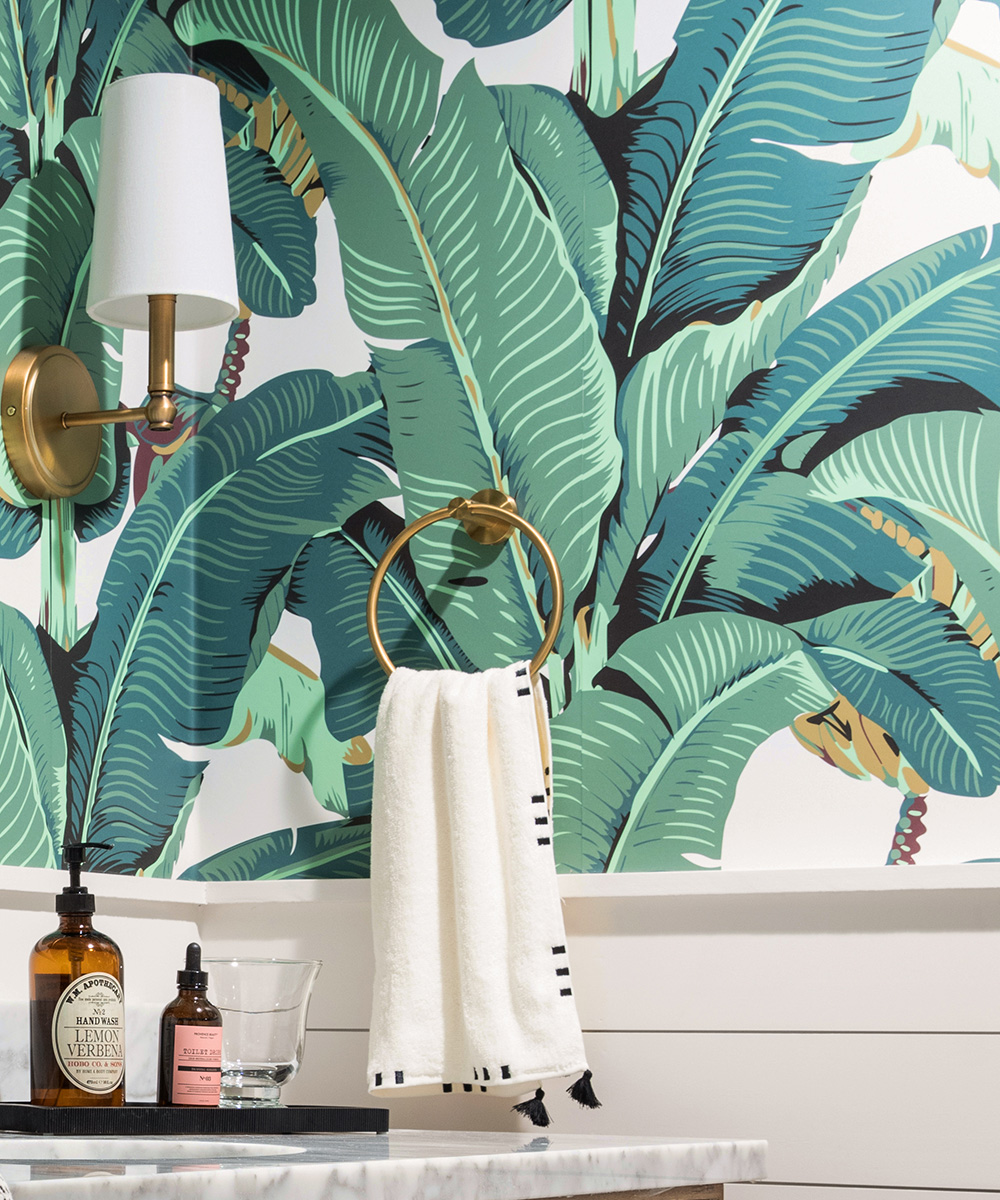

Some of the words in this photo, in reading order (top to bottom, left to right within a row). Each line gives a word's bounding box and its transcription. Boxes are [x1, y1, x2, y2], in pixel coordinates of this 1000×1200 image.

[66, 988, 83, 1004] W.M.
[76, 1017, 100, 1025] HAND
[101, 1017, 119, 1025] WASH
[75, 1029, 119, 1043] LEMON
[67, 1043, 123, 1057] VERBENA
